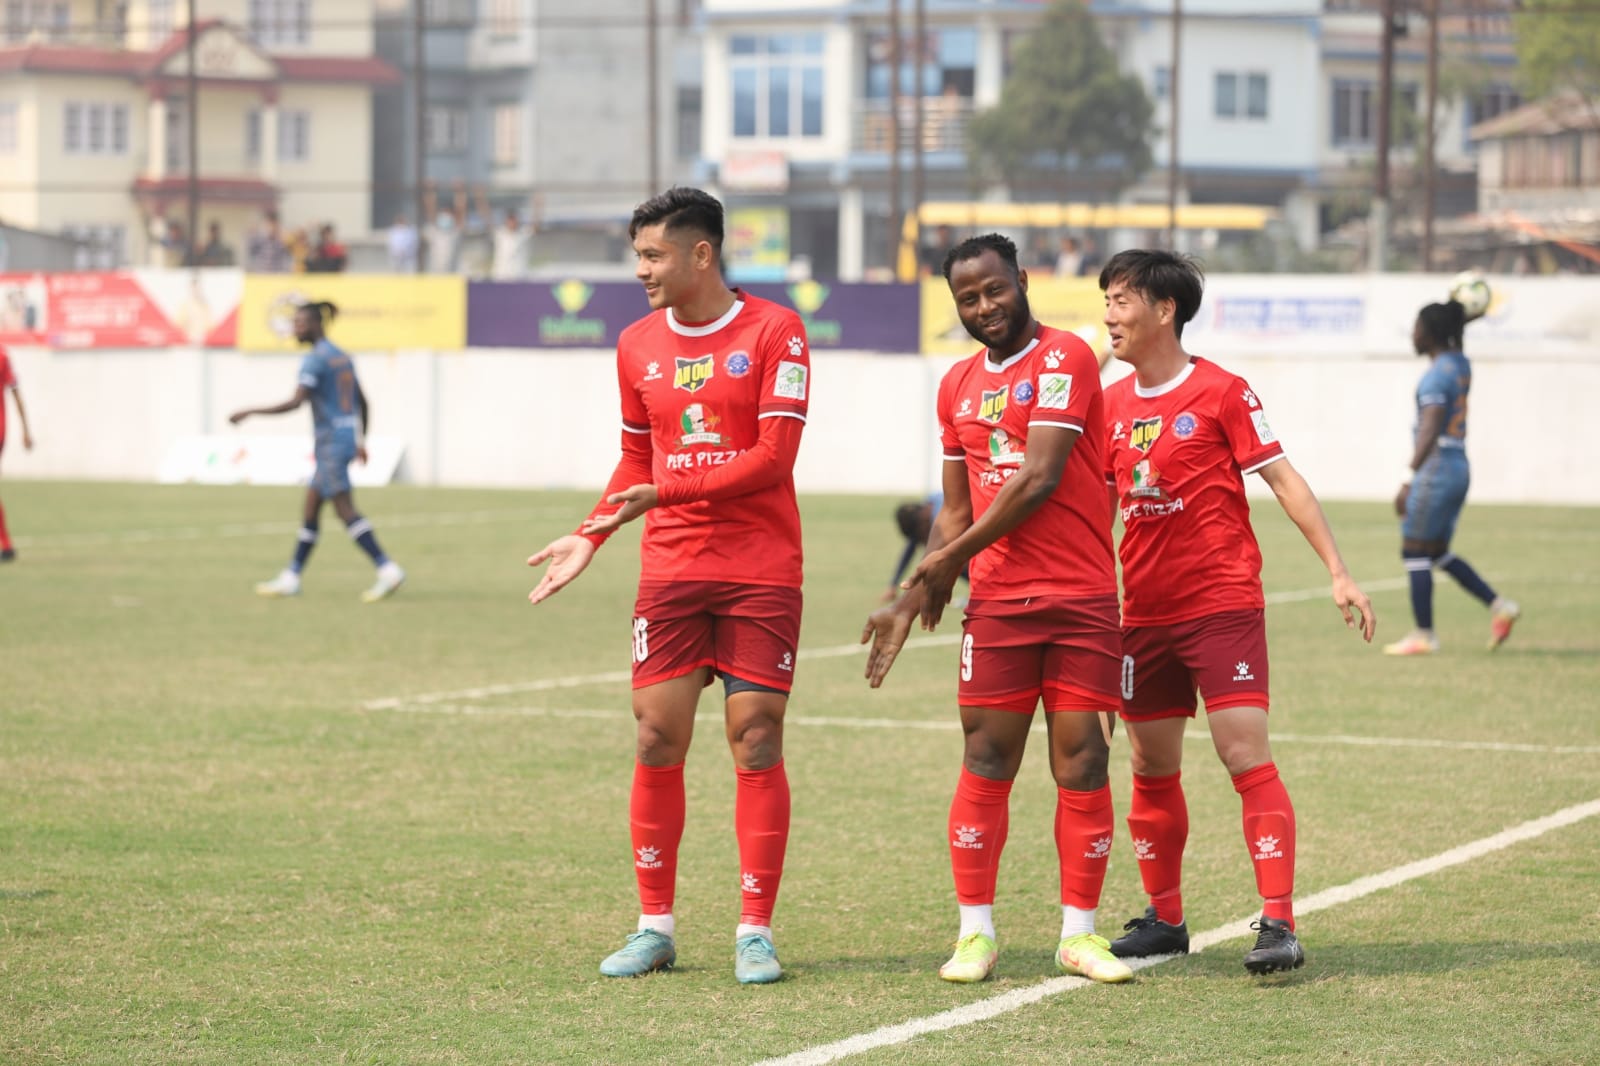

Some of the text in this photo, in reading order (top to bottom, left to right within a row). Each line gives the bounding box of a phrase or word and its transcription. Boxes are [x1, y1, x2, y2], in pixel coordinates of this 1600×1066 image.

[666, 448, 747, 469] PEPE PIZZ
[961, 633, 974, 682] 9
